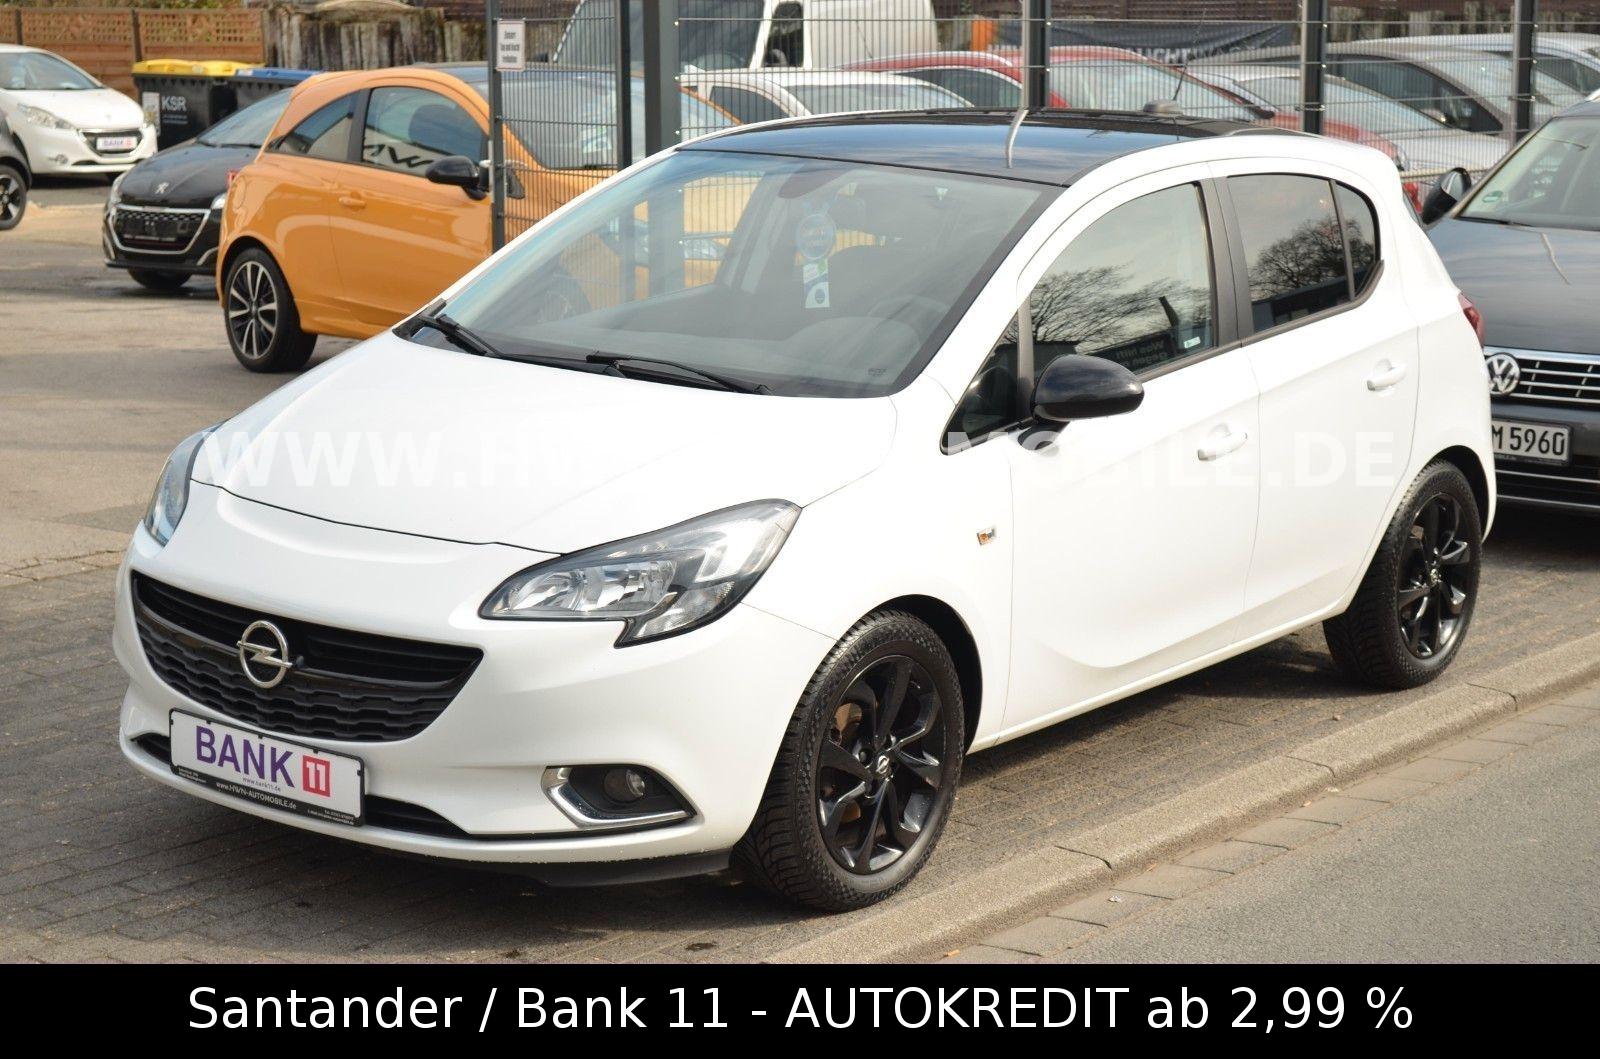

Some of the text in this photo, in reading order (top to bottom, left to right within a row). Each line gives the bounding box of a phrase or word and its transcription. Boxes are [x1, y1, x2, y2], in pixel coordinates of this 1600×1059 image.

[162, 95, 187, 112] KSR
[1509, 426, 1566, 456] 5960
[196, 725, 295, 789] BANK
[305, 759, 327, 793] 11
